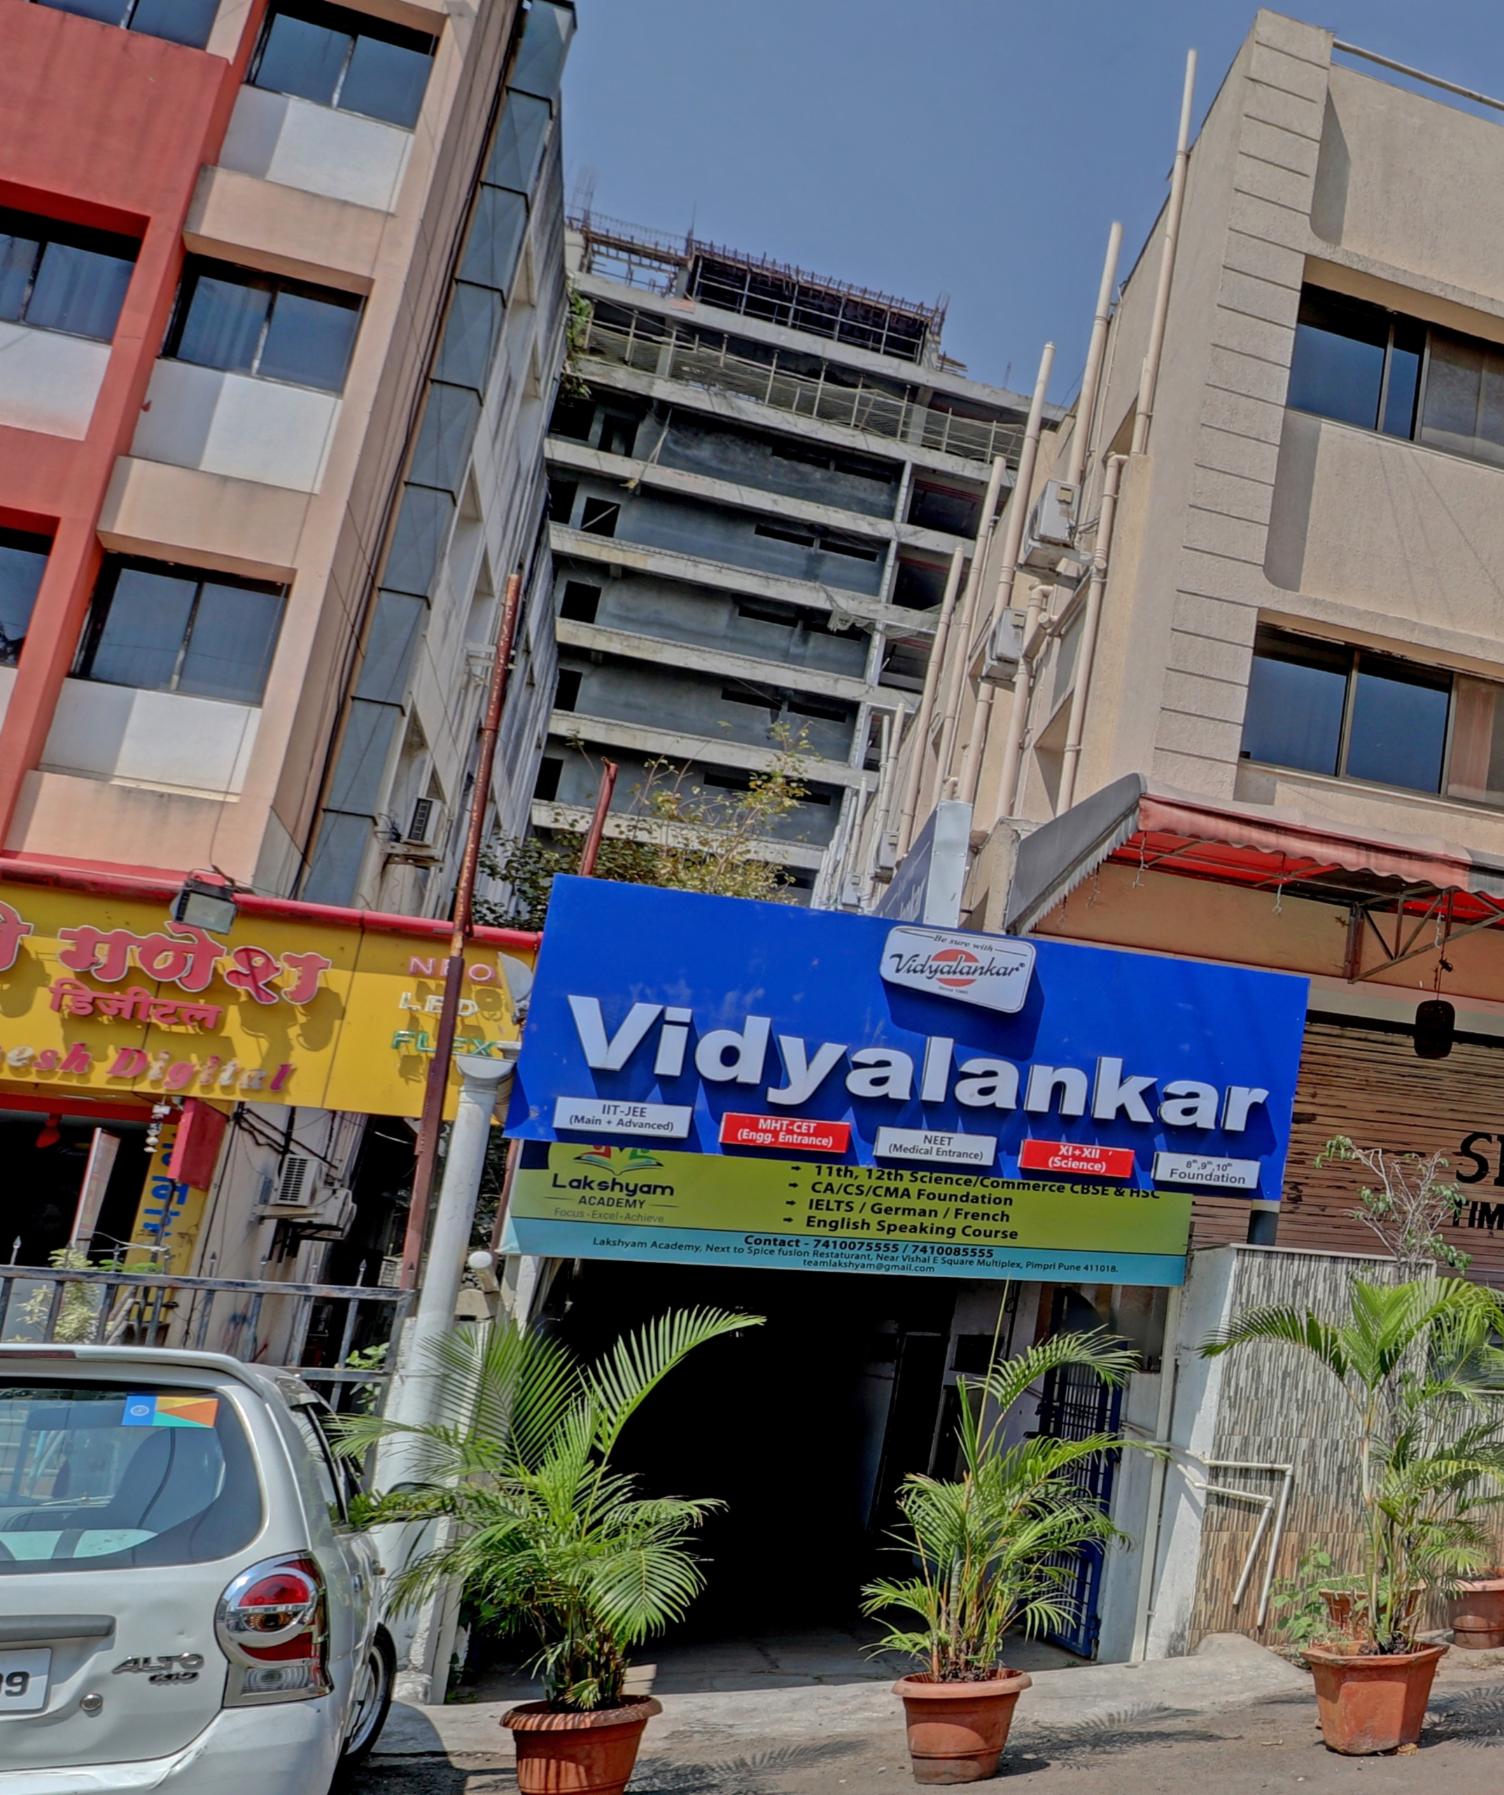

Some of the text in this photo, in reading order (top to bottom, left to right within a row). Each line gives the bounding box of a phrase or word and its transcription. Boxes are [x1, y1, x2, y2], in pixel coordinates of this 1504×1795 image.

[933, 934, 947, 943] Be
[972, 942, 994, 953] with
[0, 1042, 296, 1092] esh Digital
[568, 994, 1269, 1133] Vidyalankar
[602, 1104, 648, 1118] IIT-JEE
[569, 1115, 602, 1126] (Main
[616, 1118, 674, 1132] Advanced)
[758, 1119, 817, 1134] MHT-CET
[737, 1129, 834, 1148] (Engg. Entrance)
[923, 1134, 954, 1147] NEET
[888, 1143, 984, 1161] (Medical Entrance)
[1057, 1145, 1101, 1159] XI+XII
[1048, 1157, 1107, 1173] (Science)
[551, 1173, 675, 1197] Lakshyam
[814, 1165, 860, 1182] 11th,
[866, 1168, 904, 1182] 12th
[909, 1171, 1065, 1194] Science/Commerce
[1070, 1183, 1109, 1196] CBSE
[1169, 1168, 1246, 1185] Foundation
[578, 1195, 646, 1209] ACADEMY
[811, 1181, 1014, 1207] CA/CS/CMA Foundation
[554, 1207, 665, 1223] Focus Excel Achieve
[808, 1198, 854, 1213] IELTS
[870, 1204, 938, 1219] German
[954, 1208, 1010, 1223] French
[806, 1215, 1019, 1240] English Speaking Course
[592, 1237, 648, 1249] Lakshyam
[650, 1240, 702, 1252] Academy,
[705, 1244, 730, 1254] Next
[733, 1246, 744, 1254] to
[746, 1246, 775, 1257] Spice
[777, 1247, 810, 1257] fusion
[876, 1253, 899, 1263] Near
[901, 1254, 930, 1264] Vishal
[941, 1257, 977, 1267] Square
[978, 1259, 1023, 1269] Multiplex,
[1026, 1261, 1056, 1271] Pimpri
[1058, 1263, 1081, 1271] Pune
[744, 1235, 800, 1247] Contact
[813, 1239, 900, 1254] 7410075555
[911, 1244, 994, 1258] 7410085555
[802, 1258, 935, 1273] teamlakshyam@gmail.com
[112, 1653, 205, 1675] ALTO
[0, 1670, 31, 1697] 9
